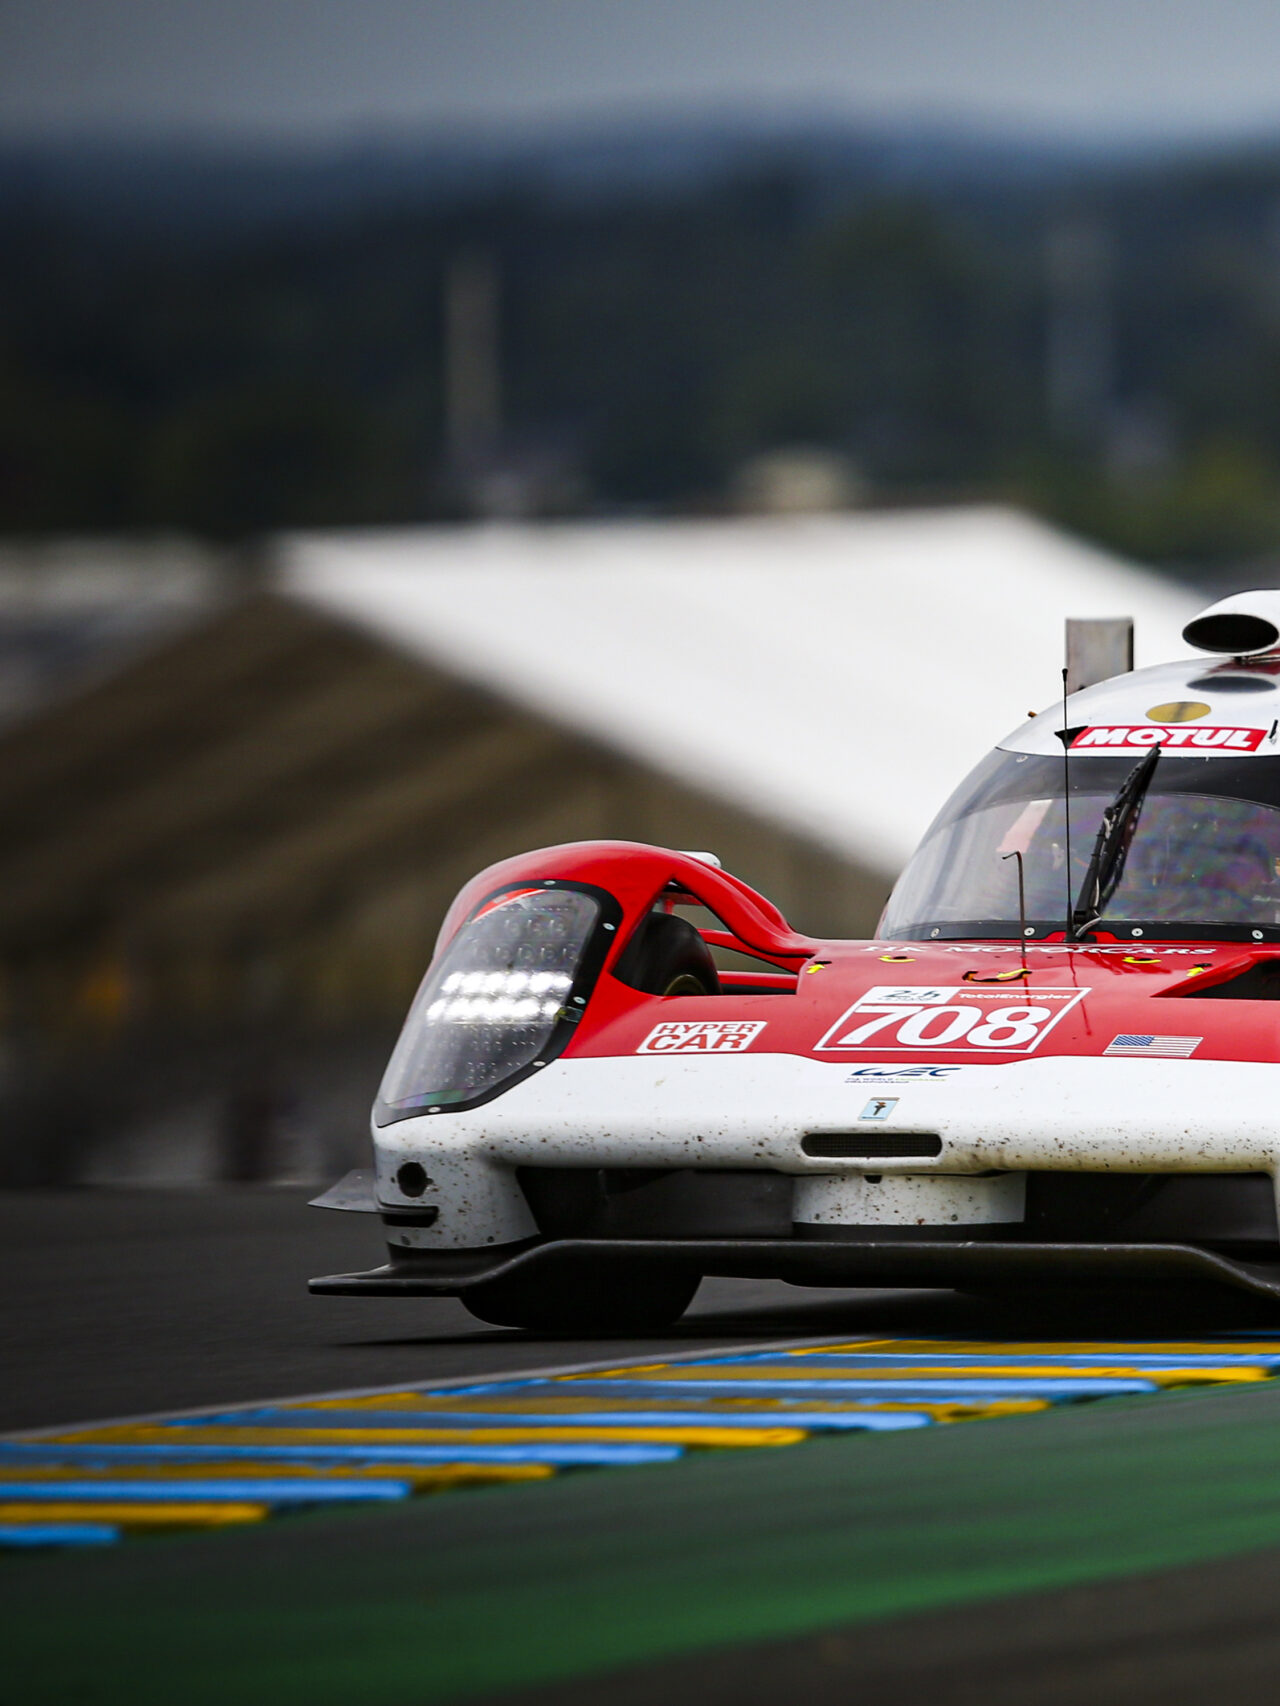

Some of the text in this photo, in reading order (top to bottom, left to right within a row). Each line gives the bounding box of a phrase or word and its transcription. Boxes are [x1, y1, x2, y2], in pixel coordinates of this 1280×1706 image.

[1075, 728, 1253, 749] MOTUL
[943, 945, 1218, 955] MOTORCARS
[656, 1023, 758, 1034] HYPER
[837, 1005, 1052, 1047] 708
[646, 1033, 748, 1050] CAR
[850, 1066, 962, 1077] WEC
